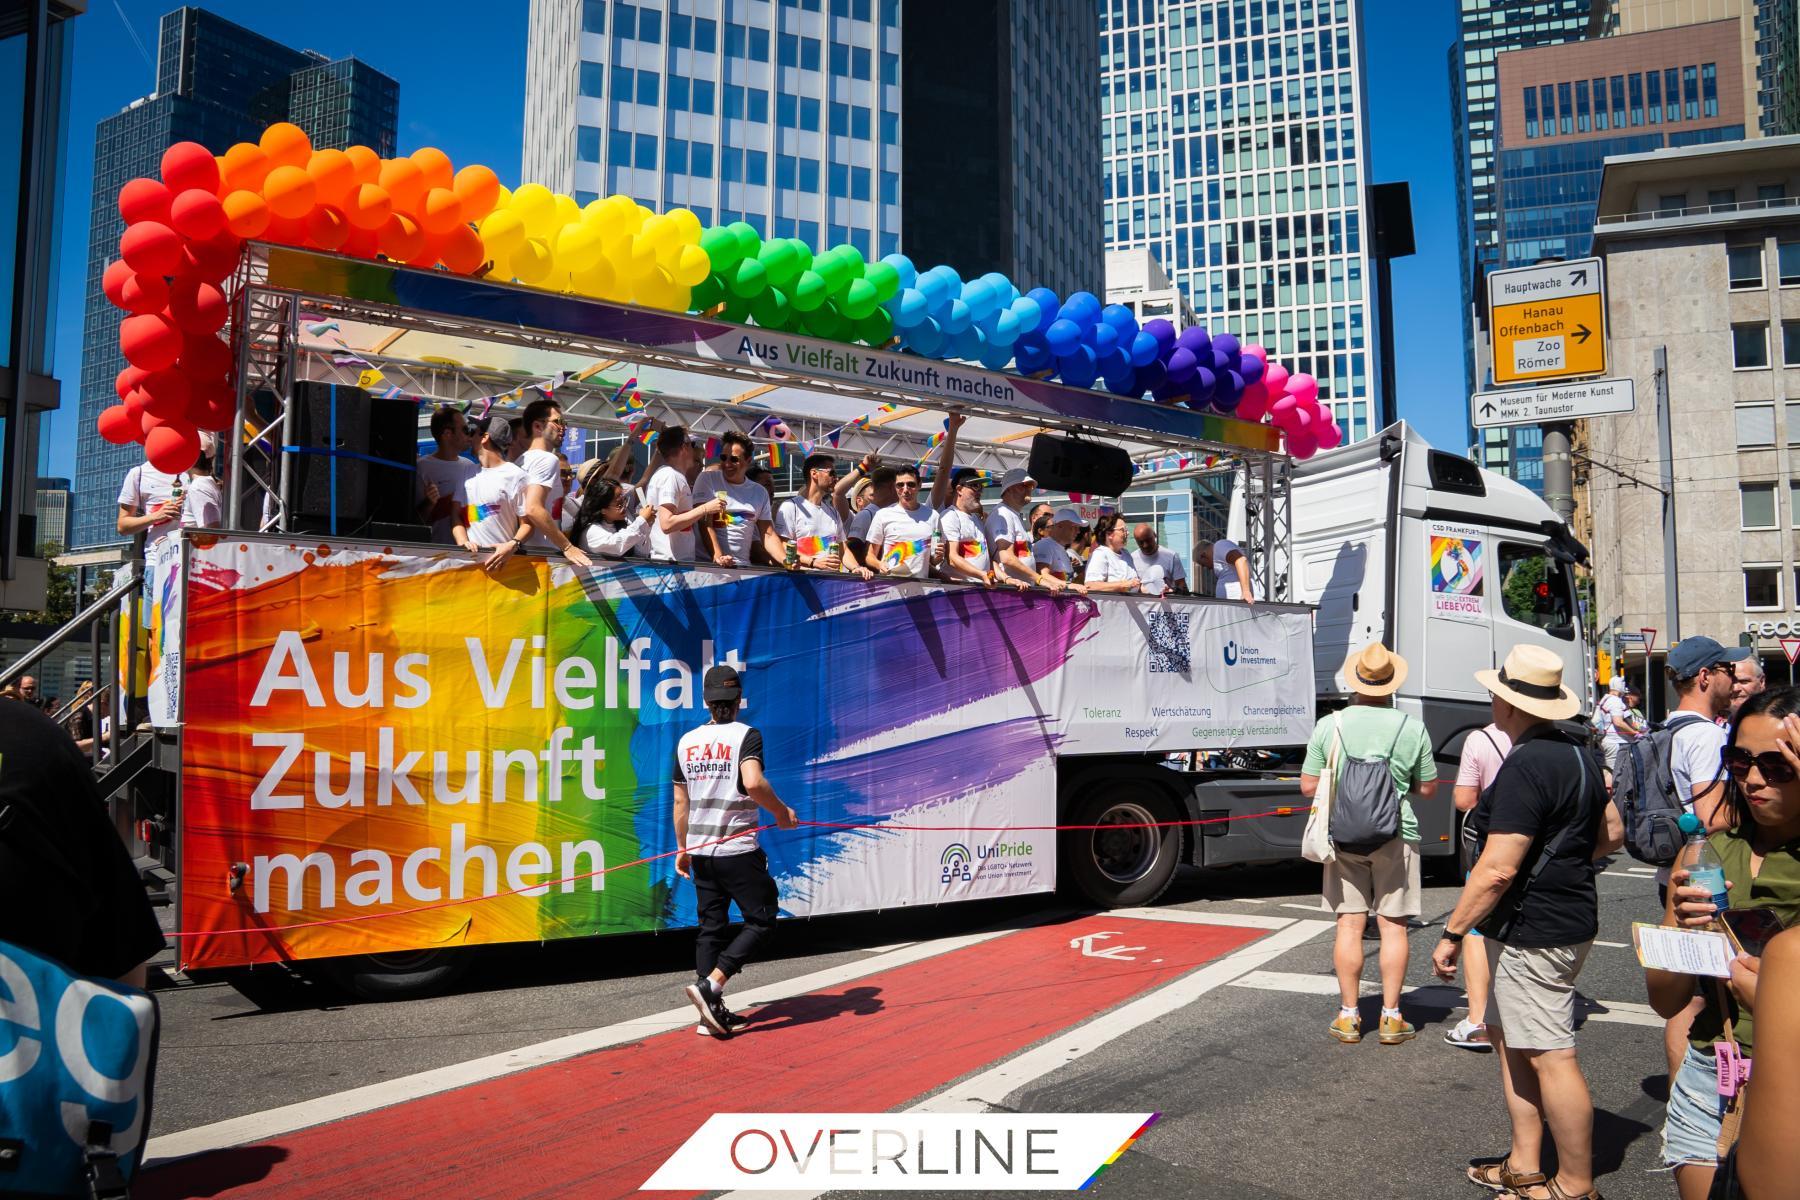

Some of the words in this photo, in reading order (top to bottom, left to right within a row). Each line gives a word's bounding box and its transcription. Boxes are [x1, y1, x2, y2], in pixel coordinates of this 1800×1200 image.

[1504, 278, 1562, 294] Hauptwache
[1523, 307, 1564, 319] Hanau
[1500, 320, 1564, 337] Offenbach
[1537, 341, 1560, 352] Zoo
[737, 335, 779, 361] Aus
[786, 343, 859, 374] Vielfalt
[865, 357, 941, 388] Zukunft
[946, 375, 1015, 401] machen
[1518, 357, 1560, 370] Römer
[1500, 396, 1533, 406] Museum
[1536, 393, 1548, 402] für
[1551, 389, 1587, 401] Moderne
[1590, 386, 1614, 396] Kunst
[1500, 409, 1520, 419] MMK
[1535, 404, 1574, 415] Taunustor
[1446, 526, 1480, 535] FRANKFURT
[1436, 600, 1482, 613] LIEBEVOLL
[1240, 646, 1260, 655] Union
[1240, 656, 1277, 665] Investment
[249, 630, 432, 710] Aus
[1082, 706, 1122, 718] Toleranz
[1151, 706, 1212, 719] Wertschätzung
[1243, 704, 1306, 718] Chancengleichheit
[1125, 727, 1159, 740] Respekt
[1192, 726, 1245, 739] Gegenseitiges
[1246, 724, 1288, 736] Verständnis
[250, 727, 606, 811] Zukunft
[977, 841, 1033, 859] UniPride
[253, 823, 606, 915] machen
